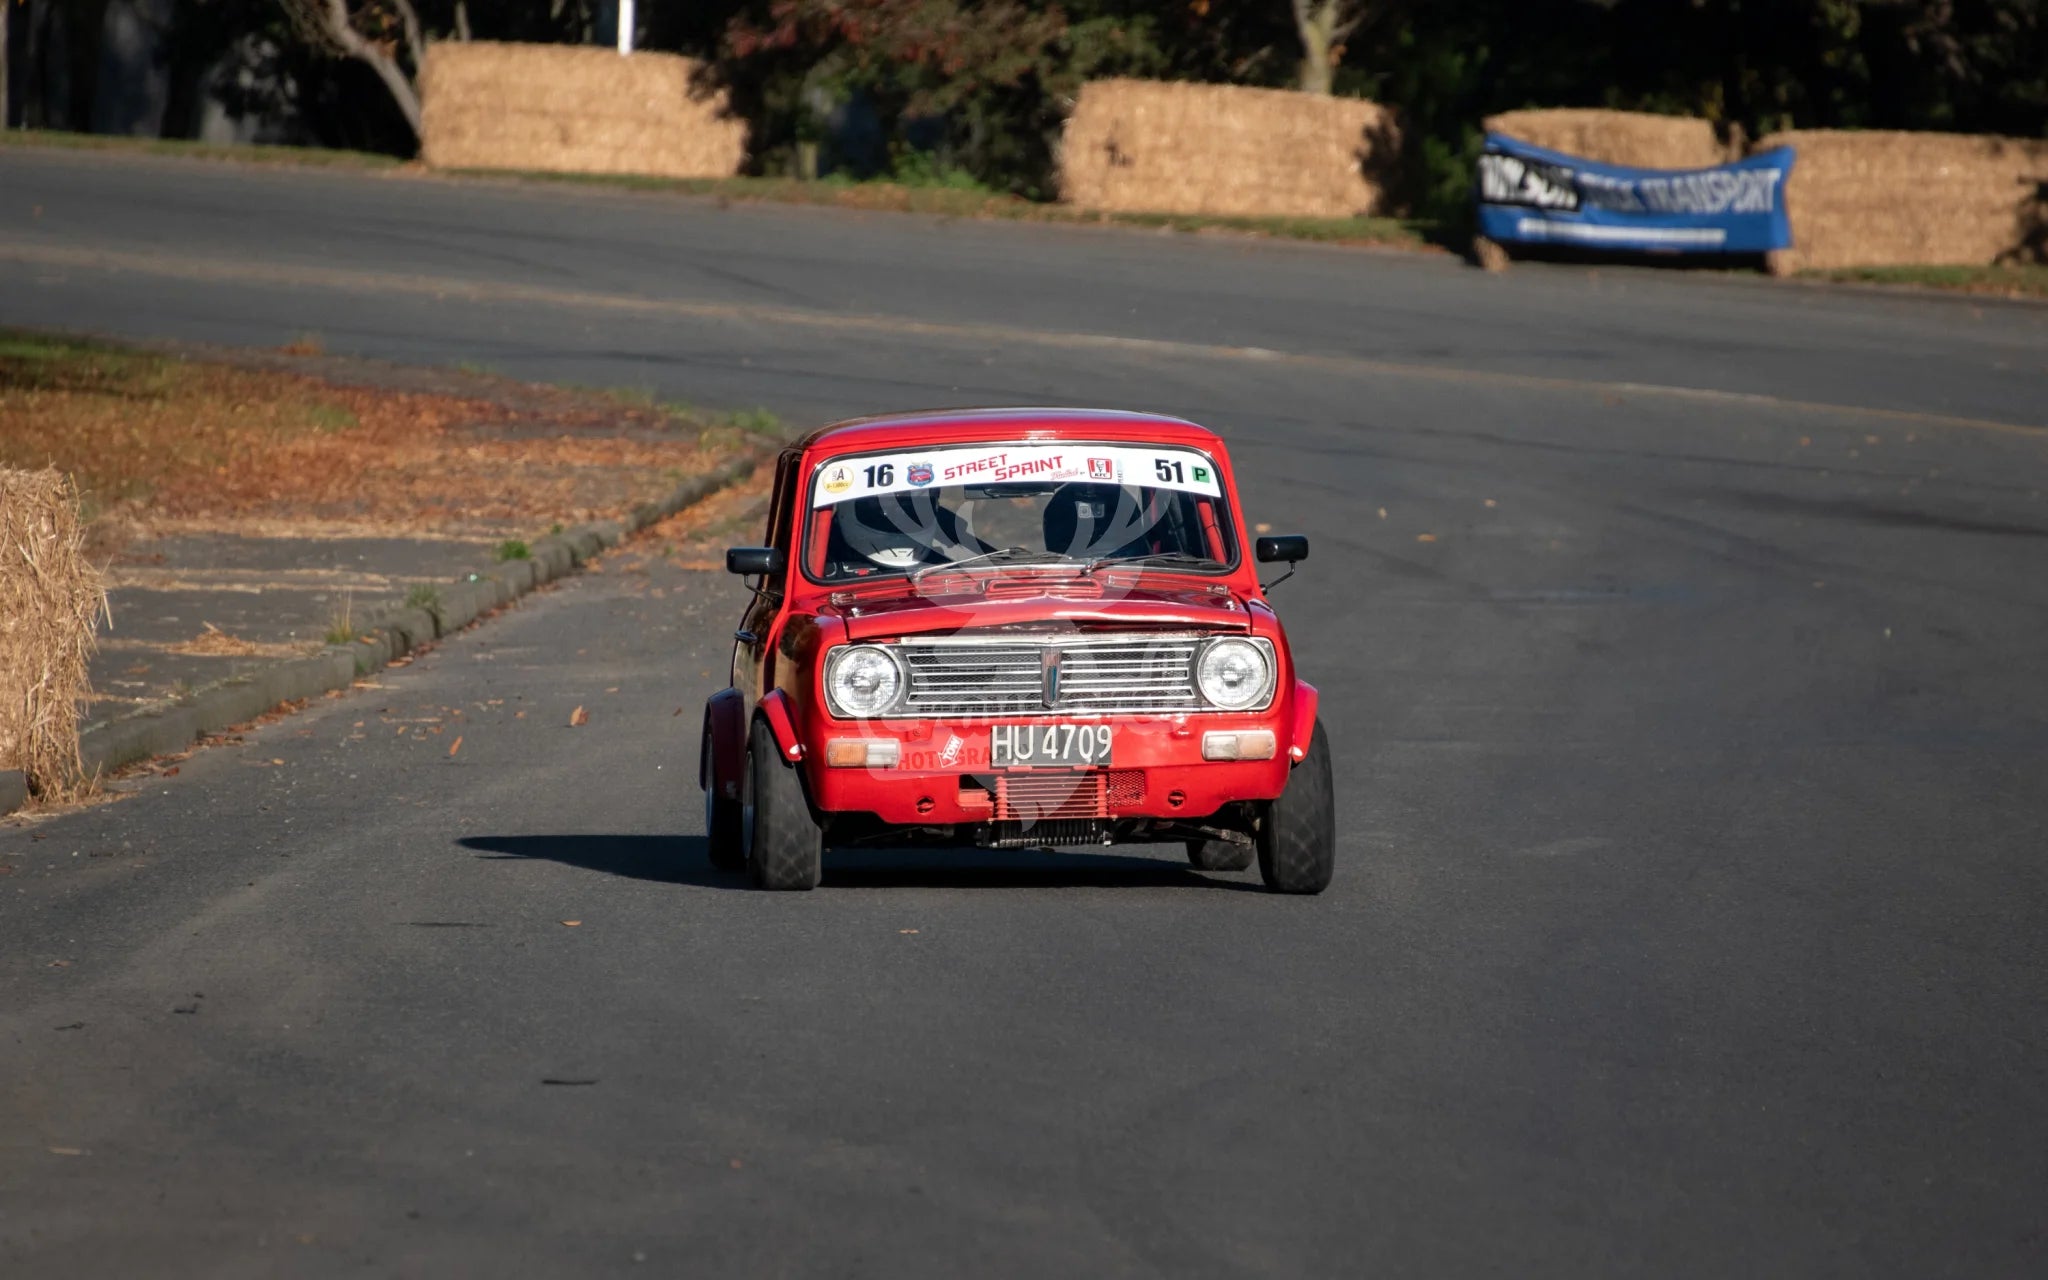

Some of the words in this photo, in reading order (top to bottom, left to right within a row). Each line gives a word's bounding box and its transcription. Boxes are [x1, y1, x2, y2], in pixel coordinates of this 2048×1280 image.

[863, 463, 894, 488] 16
[944, 454, 1008, 480] STREET
[995, 456, 1063, 481] SPRINT
[1154, 458, 1184, 483] 51
[1194, 467, 1206, 481] P
[942, 735, 961, 760] TOW
[991, 724, 1035, 761] HU
[1042, 724, 1113, 762] 4709
